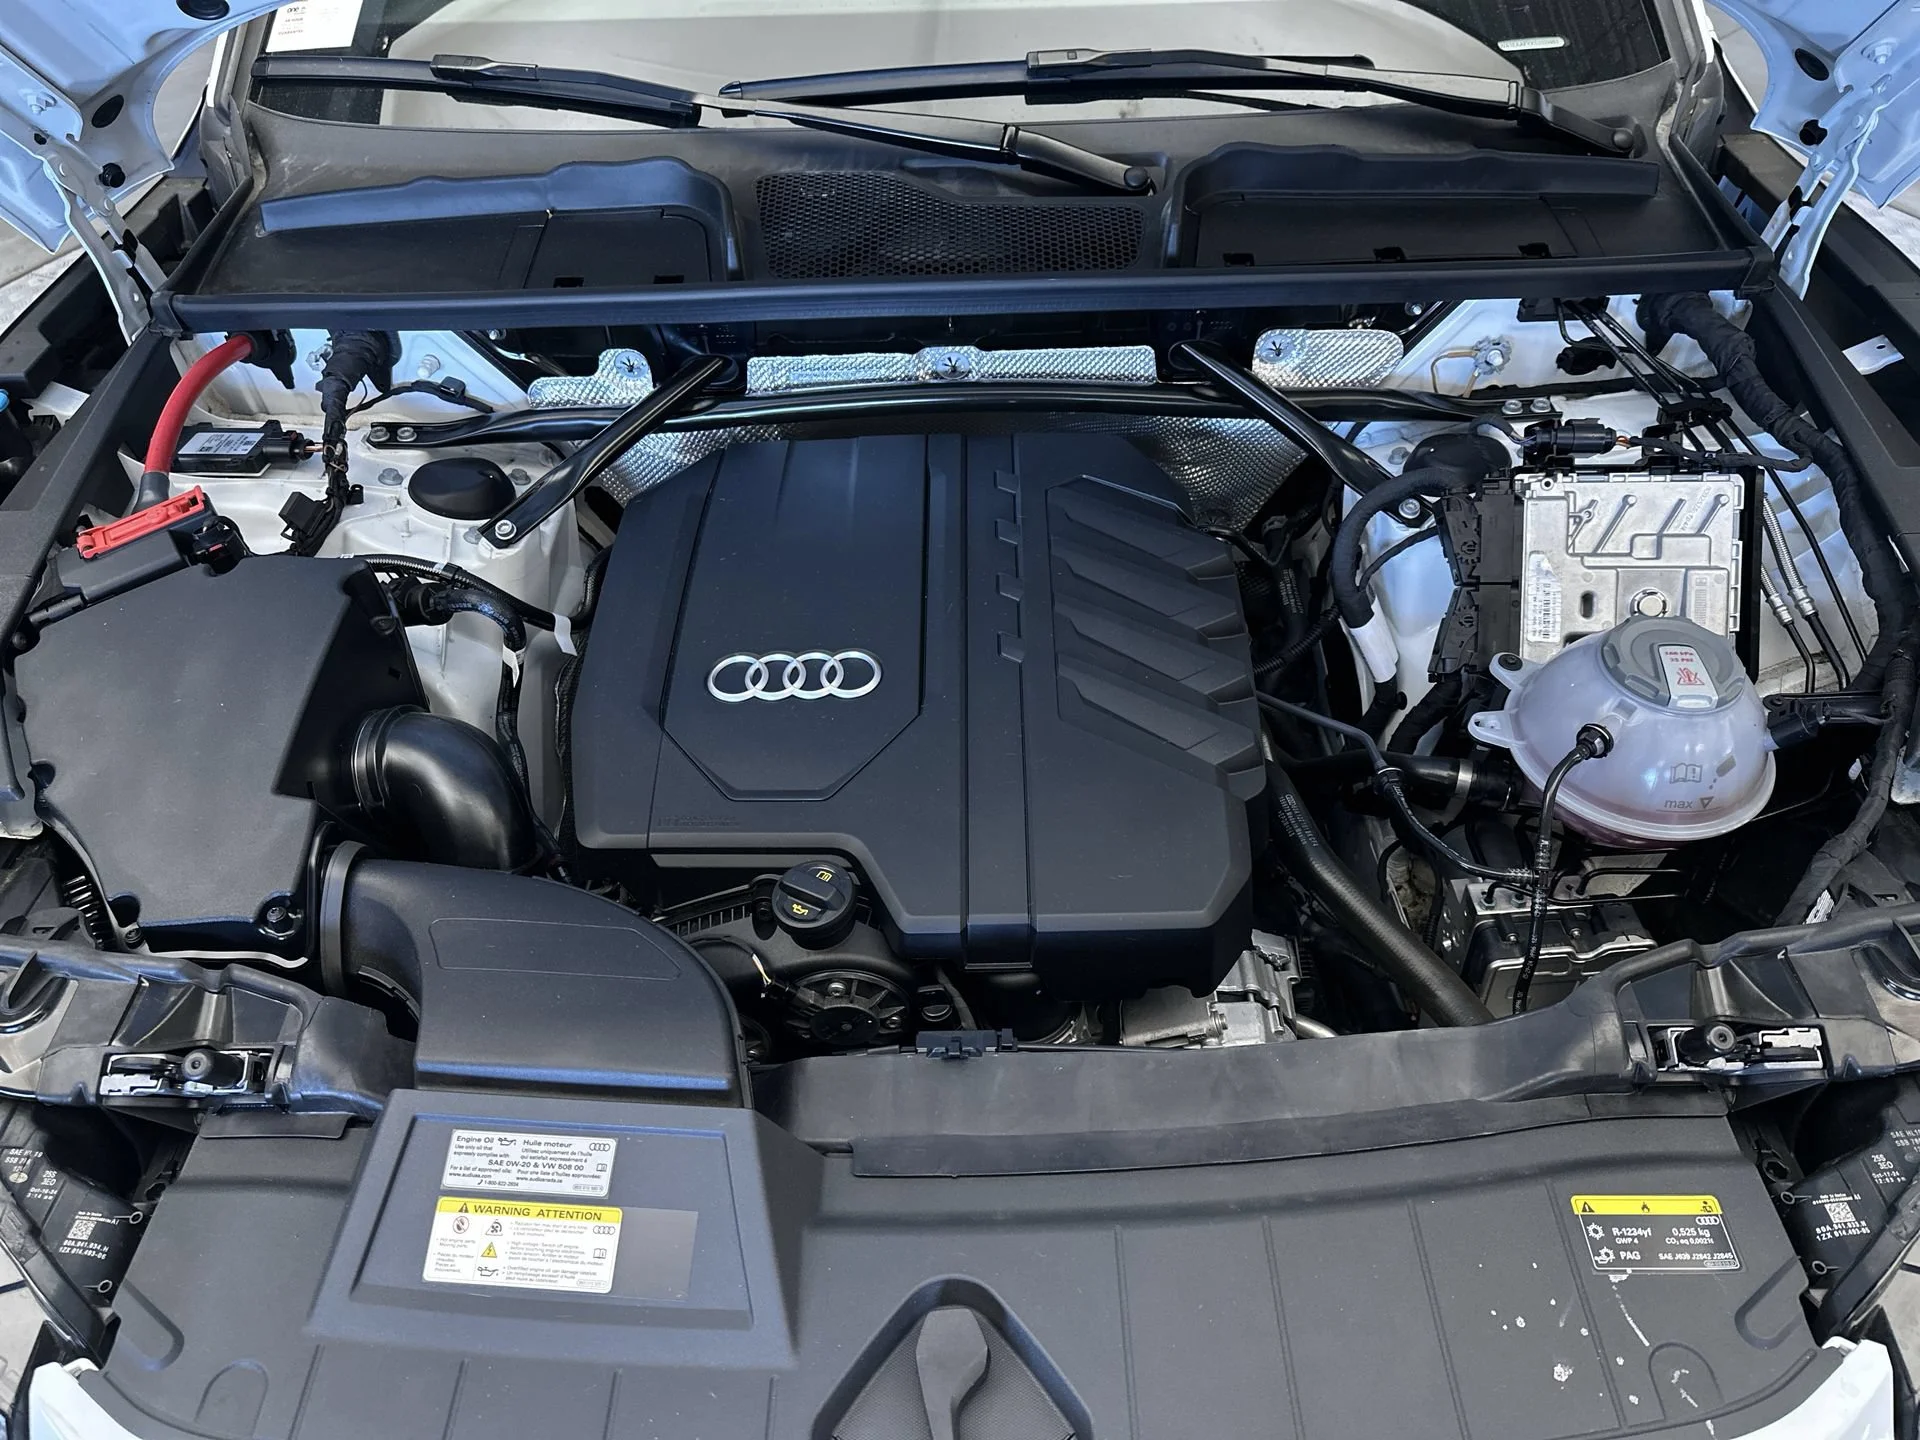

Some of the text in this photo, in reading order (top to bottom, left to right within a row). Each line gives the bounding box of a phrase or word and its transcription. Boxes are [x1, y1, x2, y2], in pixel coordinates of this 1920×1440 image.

[1664, 800, 1693, 808] max
[473, 1204, 602, 1222] WARNING ATTENTION
[1612, 1227, 1652, 1238] R-1234yf
[1672, 1228, 1711, 1238] 0,525 kg
[1816, 1232, 1833, 1242] 1ZX
[1620, 1251, 1641, 1260] PAG
